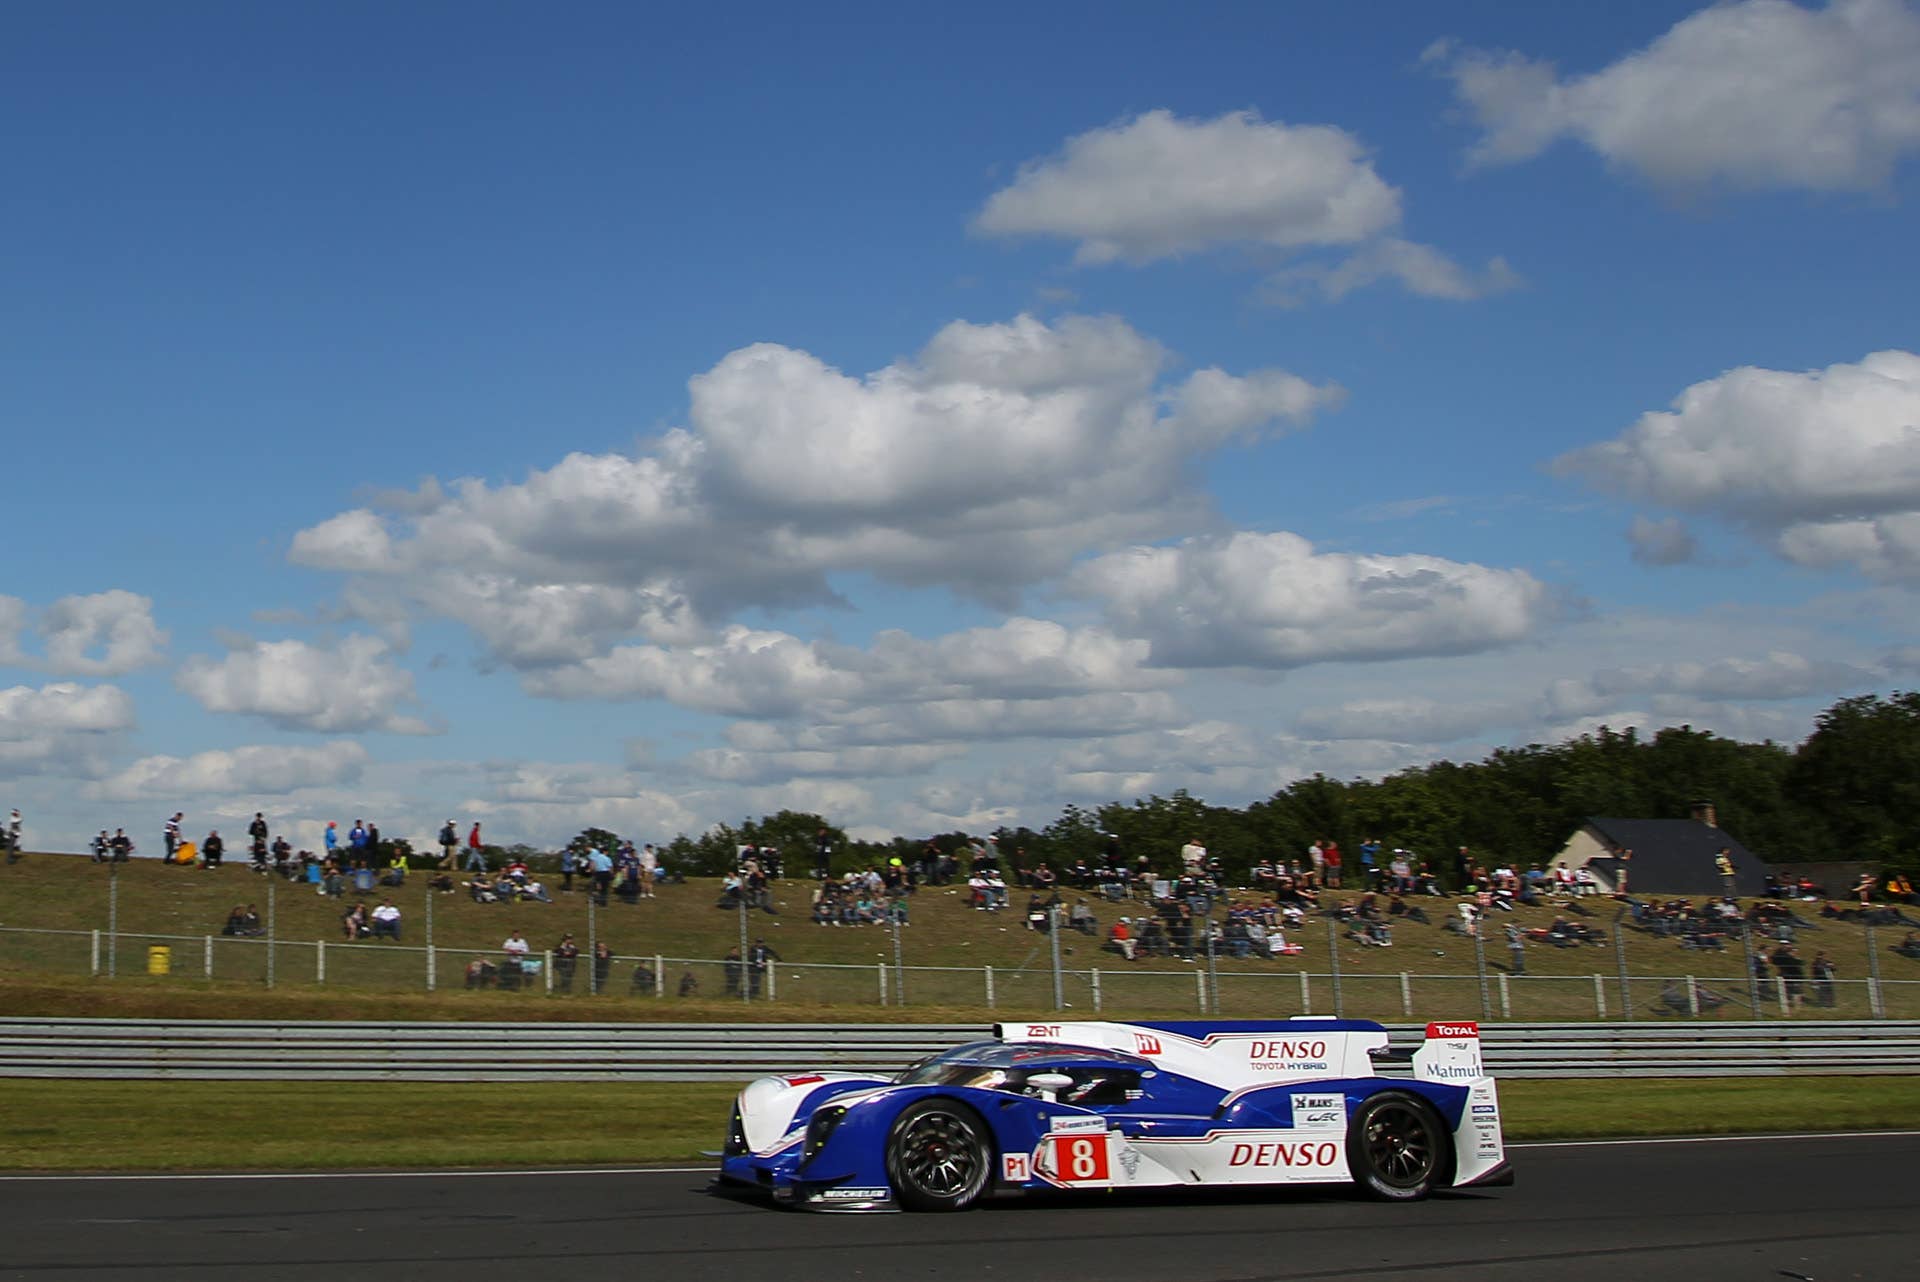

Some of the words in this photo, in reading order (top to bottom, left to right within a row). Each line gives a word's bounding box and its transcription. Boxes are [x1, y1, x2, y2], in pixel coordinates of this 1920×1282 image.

[1027, 1025, 1062, 1037] ZENT
[1435, 1025, 1477, 1035] TOTAL
[1137, 1034, 1157, 1051] HY
[1249, 1041, 1326, 1059] DENSO
[1250, 1062, 1286, 1070] TOYOTA
[1287, 1062, 1328, 1070] HYBRID
[1426, 1063, 1481, 1077] Matmut
[1072, 1139, 1096, 1178] 8
[1229, 1142, 1337, 1167] DENSO
[1006, 1158, 1026, 1177] P1
